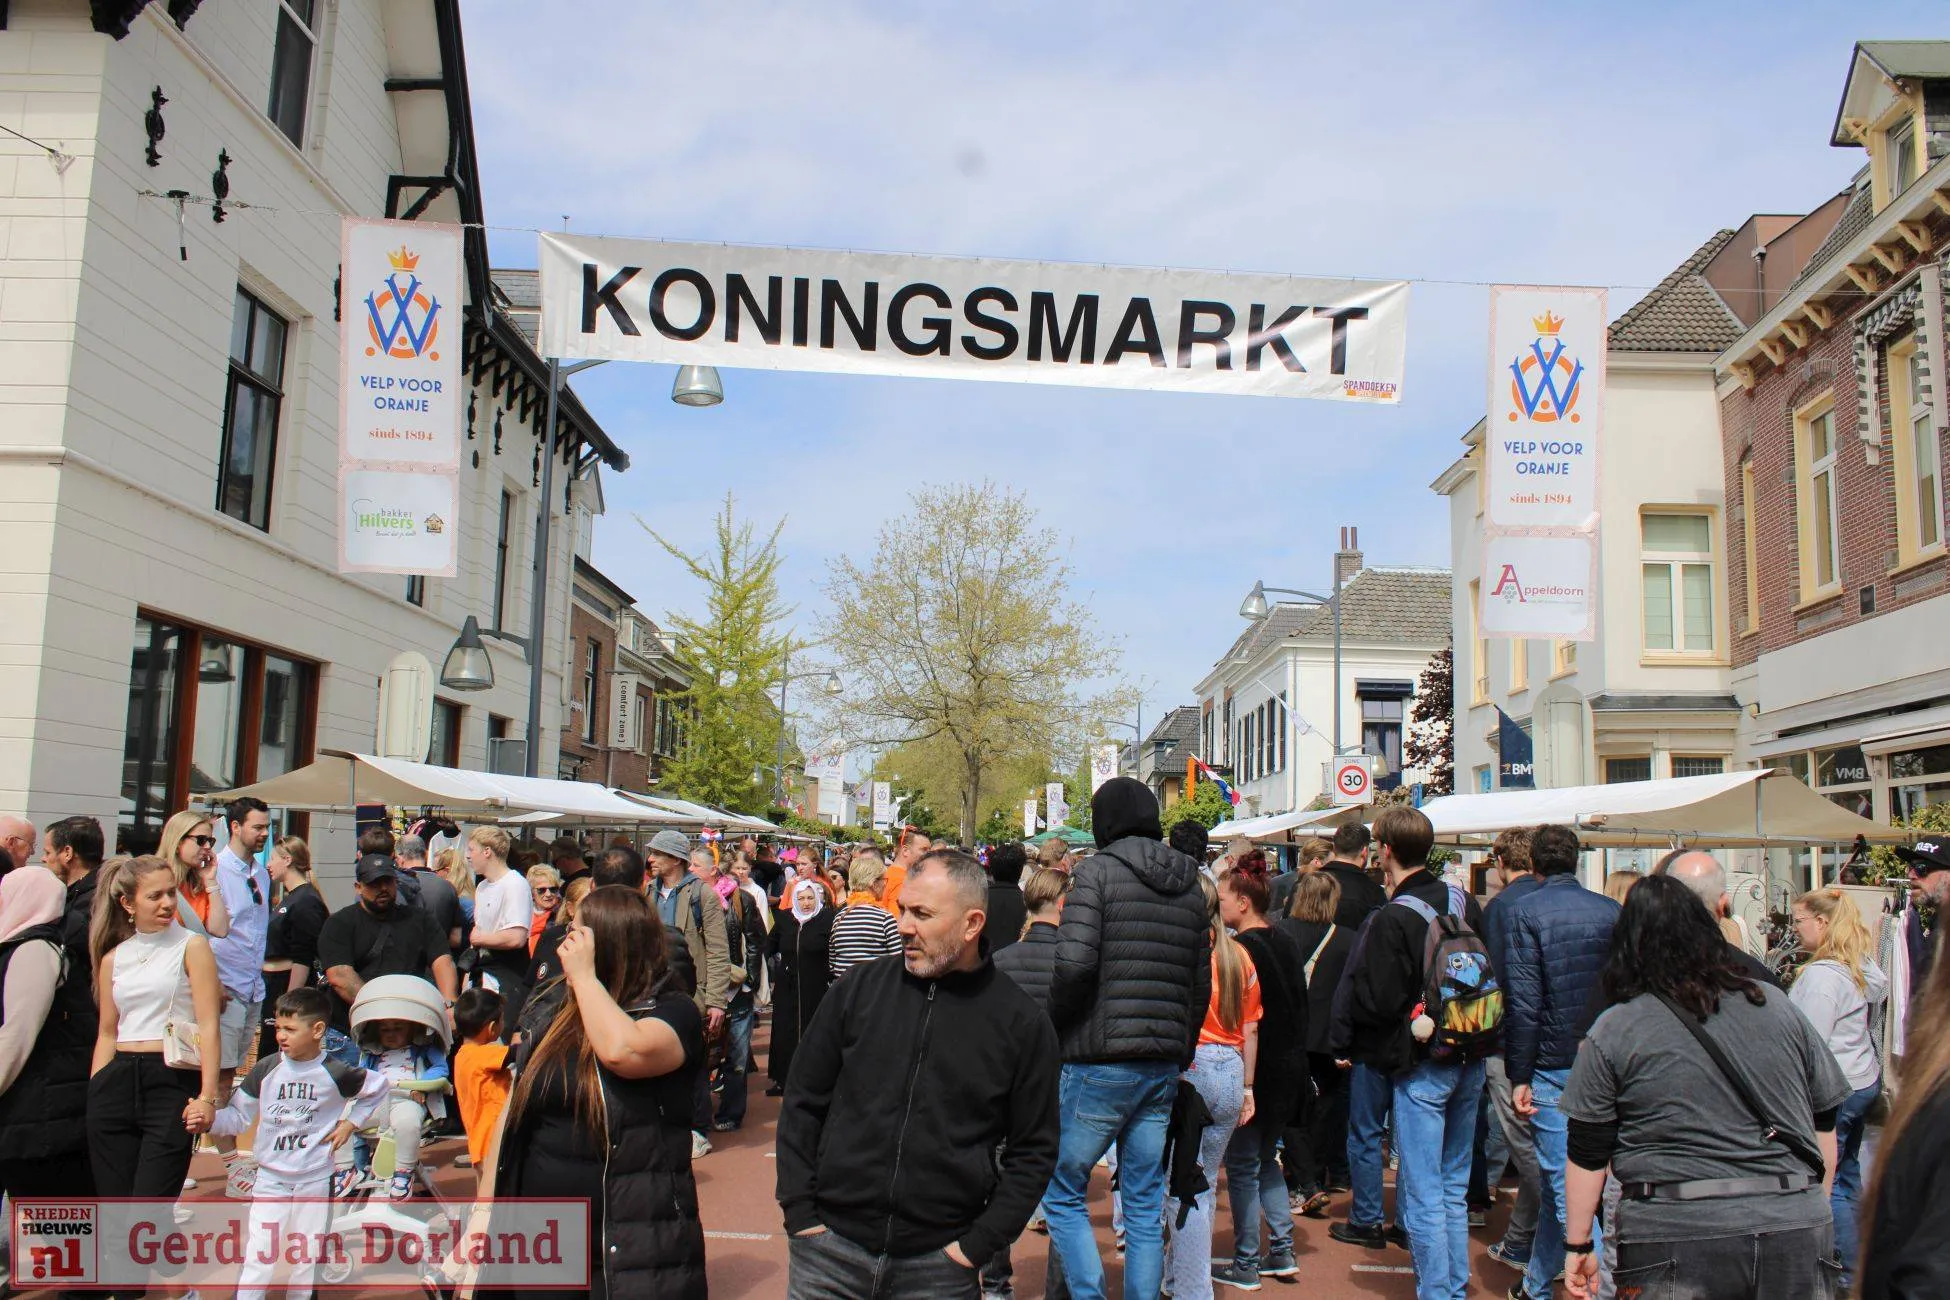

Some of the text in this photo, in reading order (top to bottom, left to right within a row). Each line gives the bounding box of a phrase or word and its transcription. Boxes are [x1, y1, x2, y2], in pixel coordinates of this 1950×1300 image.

[581, 263, 1368, 375] KONINGSMARKT
[361, 375, 442, 393] VELP VOOR
[1344, 380, 1397, 392] SPANDOEKEN
[374, 396, 429, 412] ORANJE
[369, 428, 434, 441] sinds 1894
[1504, 441, 1583, 455] VELP VOOR
[1516, 461, 1569, 475] ORANJE
[1510, 492, 1572, 504] sinds 1894
[381, 508, 413, 518] bakker
[359, 513, 415, 529] Hilvers
[1343, 774, 1362, 787] 30
[277, 1083, 318, 1101] ATHL
[267, 1103, 290, 1115] New
[274, 1134, 308, 1151] NYC
